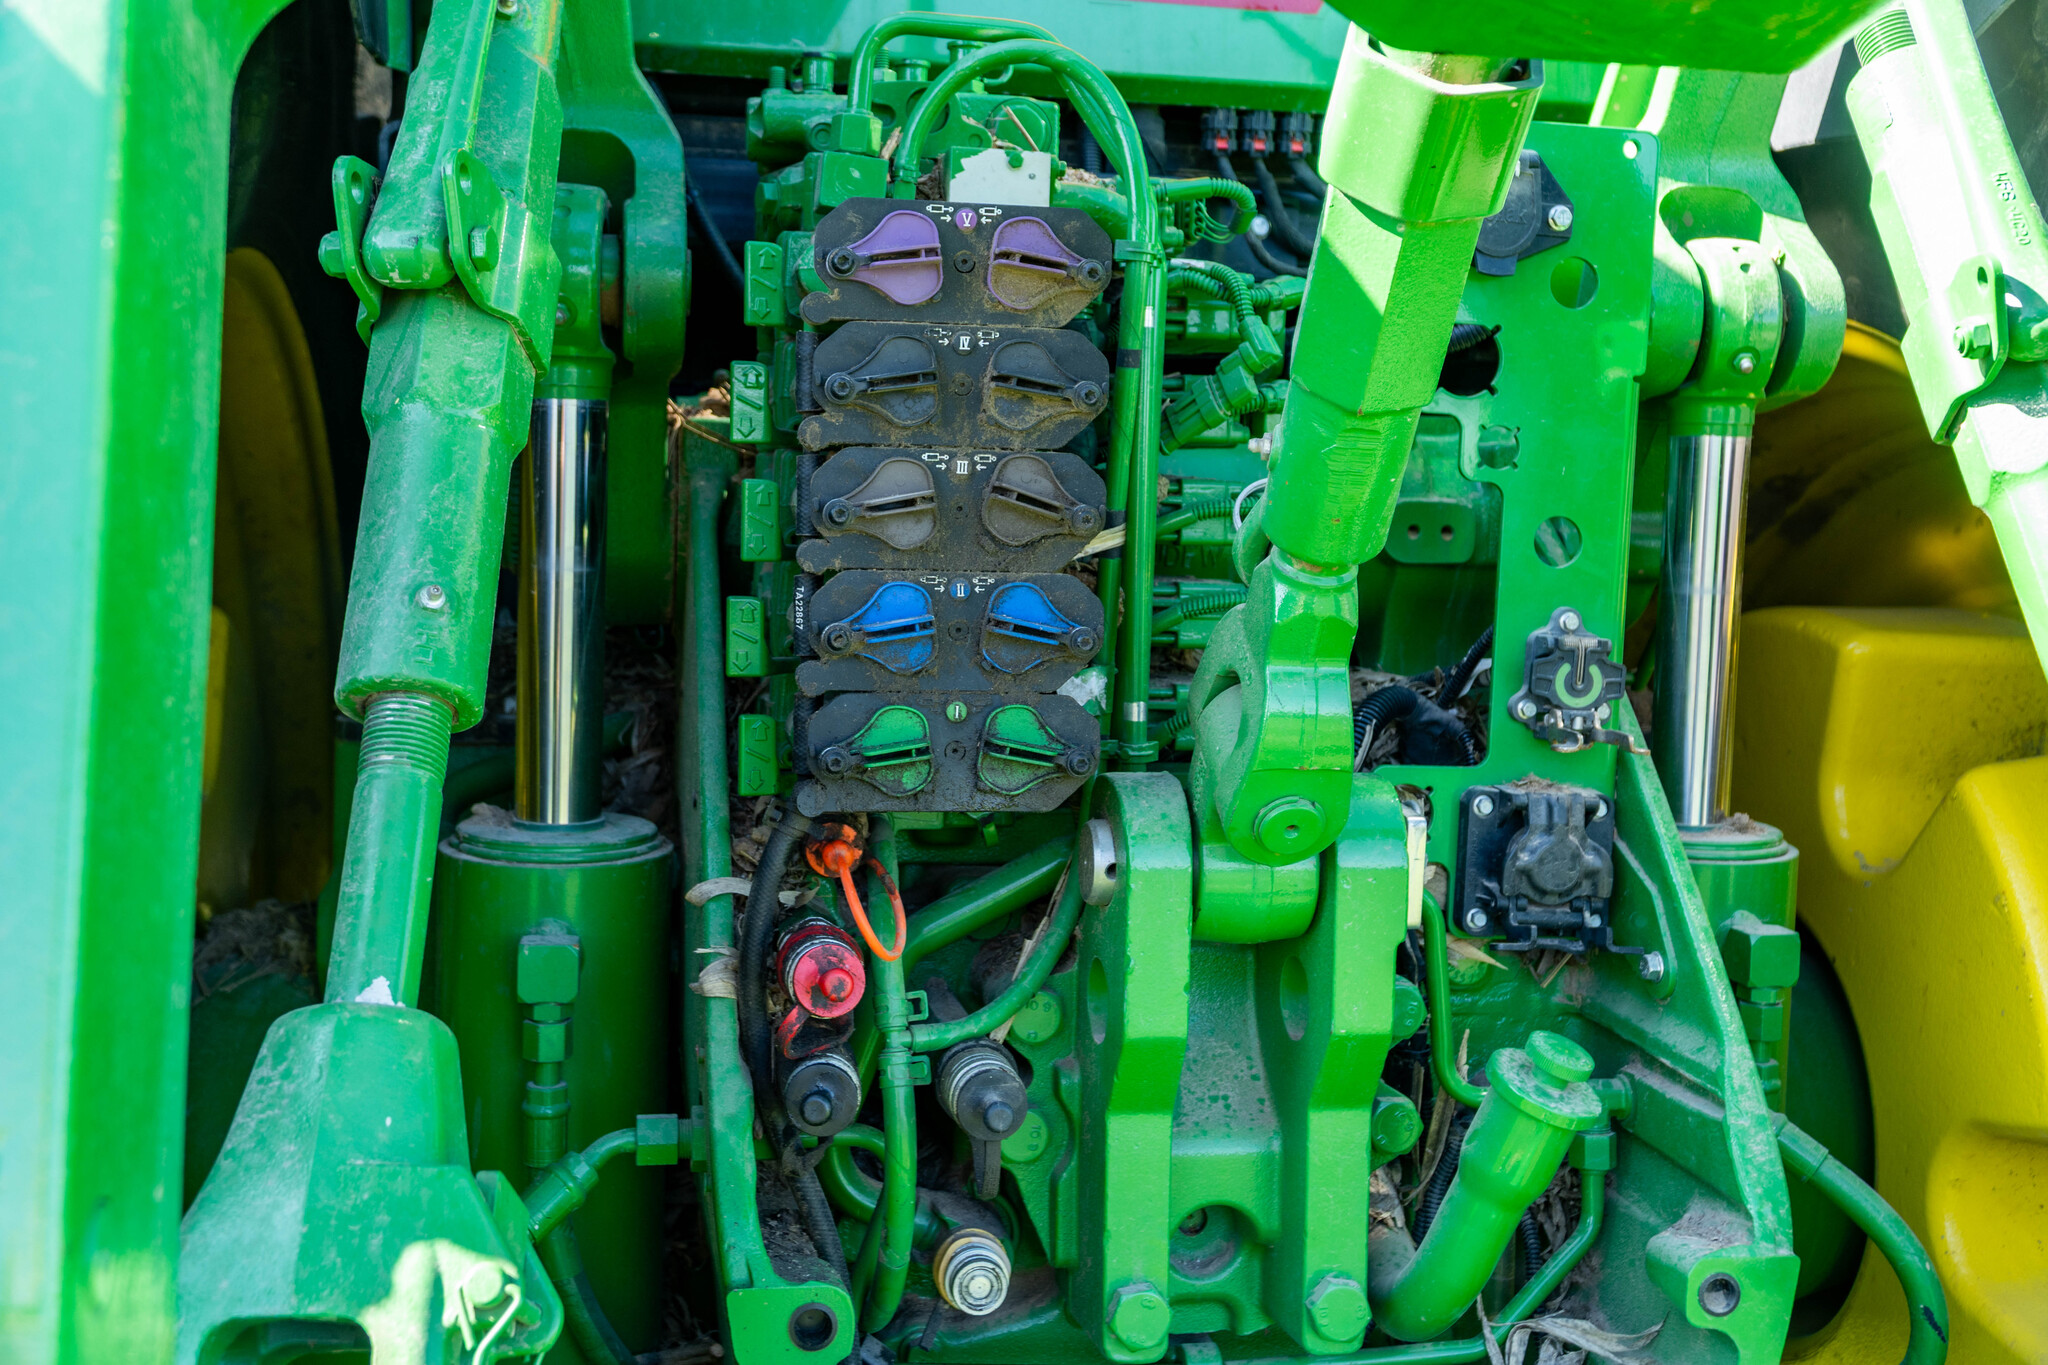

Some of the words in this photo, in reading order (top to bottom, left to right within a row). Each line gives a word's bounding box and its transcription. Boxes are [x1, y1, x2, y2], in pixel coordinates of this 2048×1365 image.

[961, 212, 973, 227] V
[959, 335, 971, 350] IV
[956, 460, 969, 475] III
[956, 583, 966, 597] II
[795, 585, 805, 631] TA22867
[954, 705, 960, 719] I
